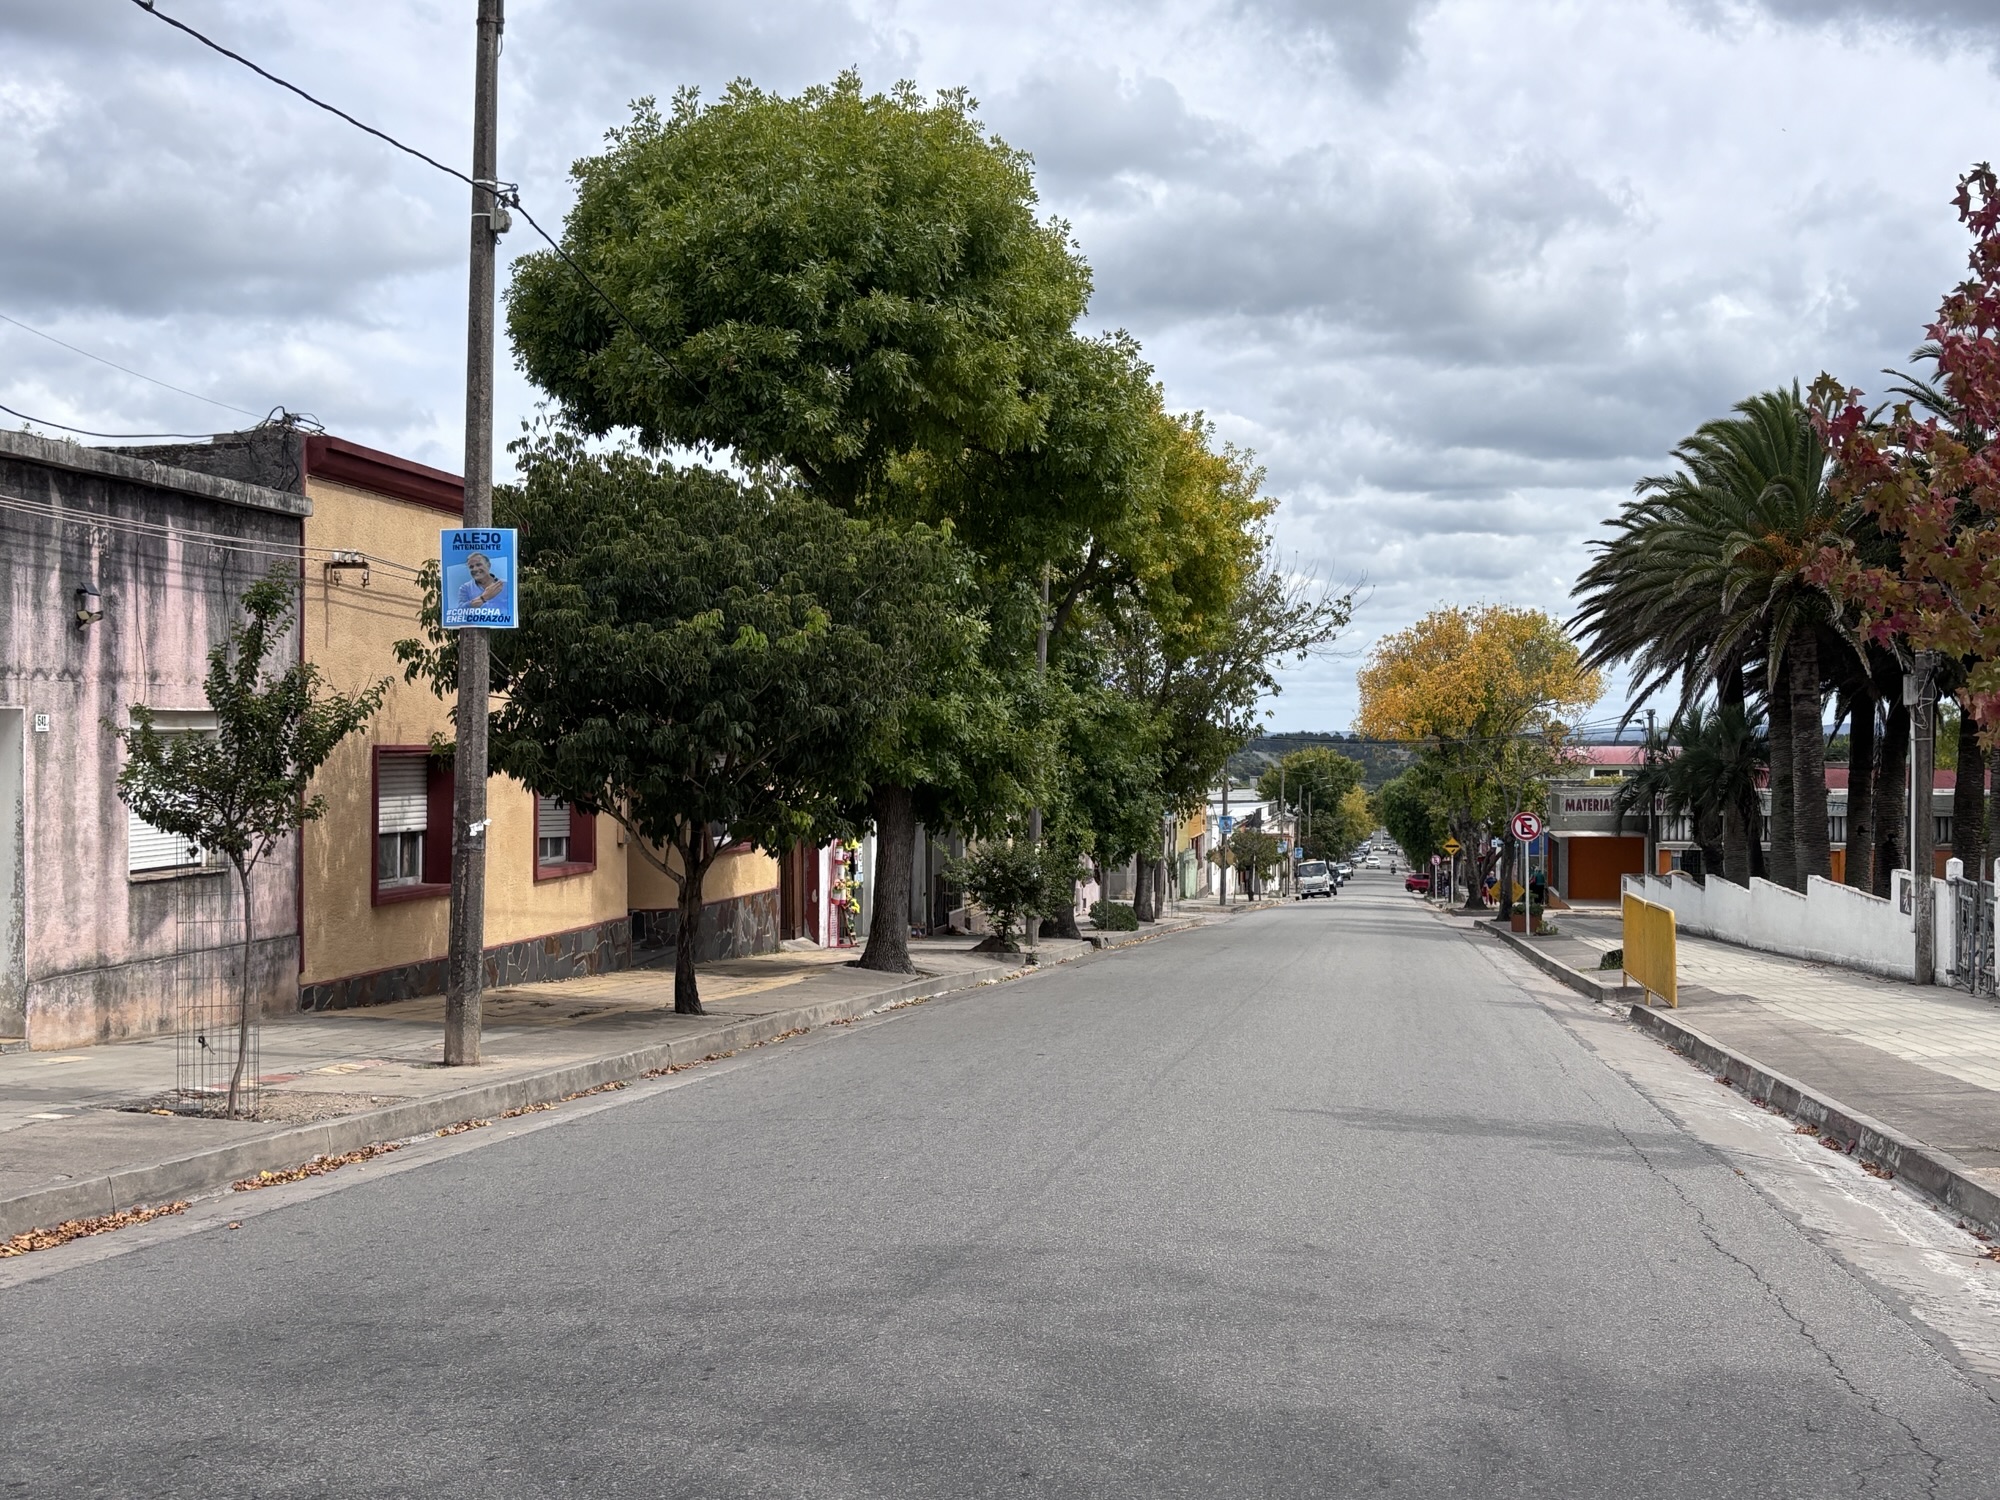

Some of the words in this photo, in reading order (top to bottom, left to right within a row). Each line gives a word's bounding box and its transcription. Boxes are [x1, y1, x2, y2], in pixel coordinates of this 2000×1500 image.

[453, 532, 501, 544] ALEJO
[446, 608, 501, 616] #CONROCHA
[1521, 817, 1532, 835] E
